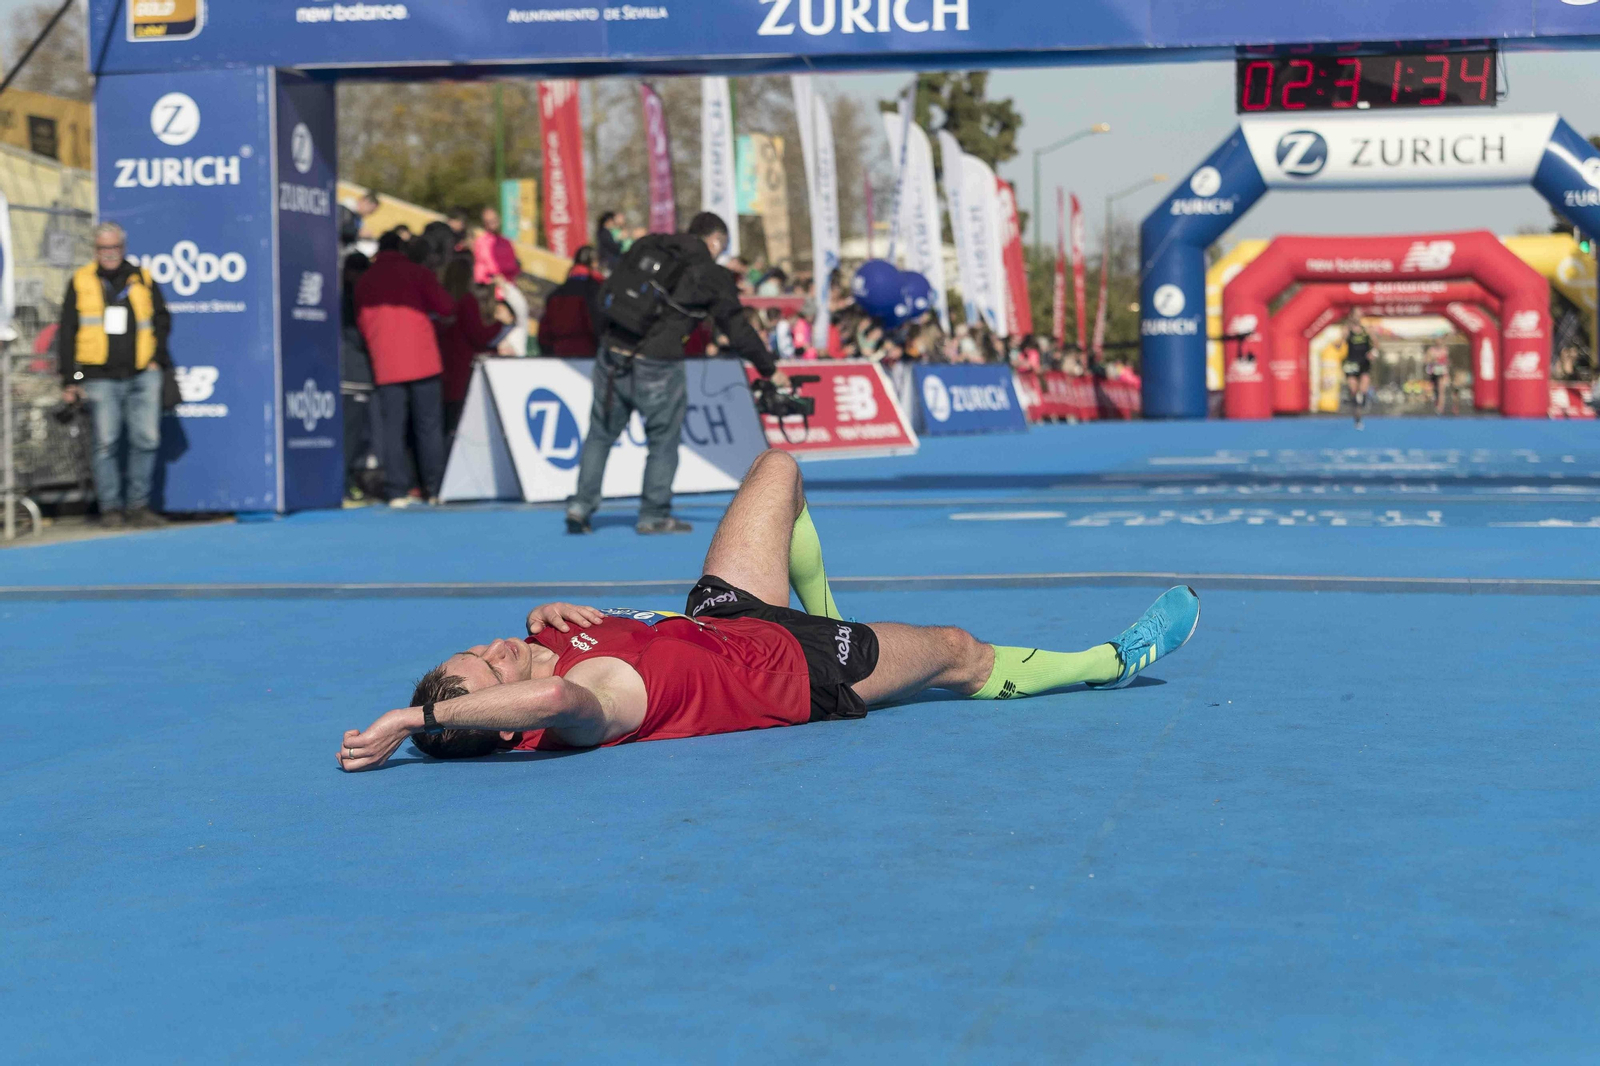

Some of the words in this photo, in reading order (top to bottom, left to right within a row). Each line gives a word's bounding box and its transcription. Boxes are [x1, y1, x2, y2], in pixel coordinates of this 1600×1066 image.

[296, 7, 333, 22] new
[333, 3, 408, 21] balance
[757, 0, 970, 36] ZURICH
[1350, 135, 1507, 167] ZURICH
[114, 156, 241, 188] ZURICH
[1170, 197, 1235, 215] ZURICH
[1563, 188, 1600, 207] ZUR
[951, 384, 1011, 413] ZURICH
